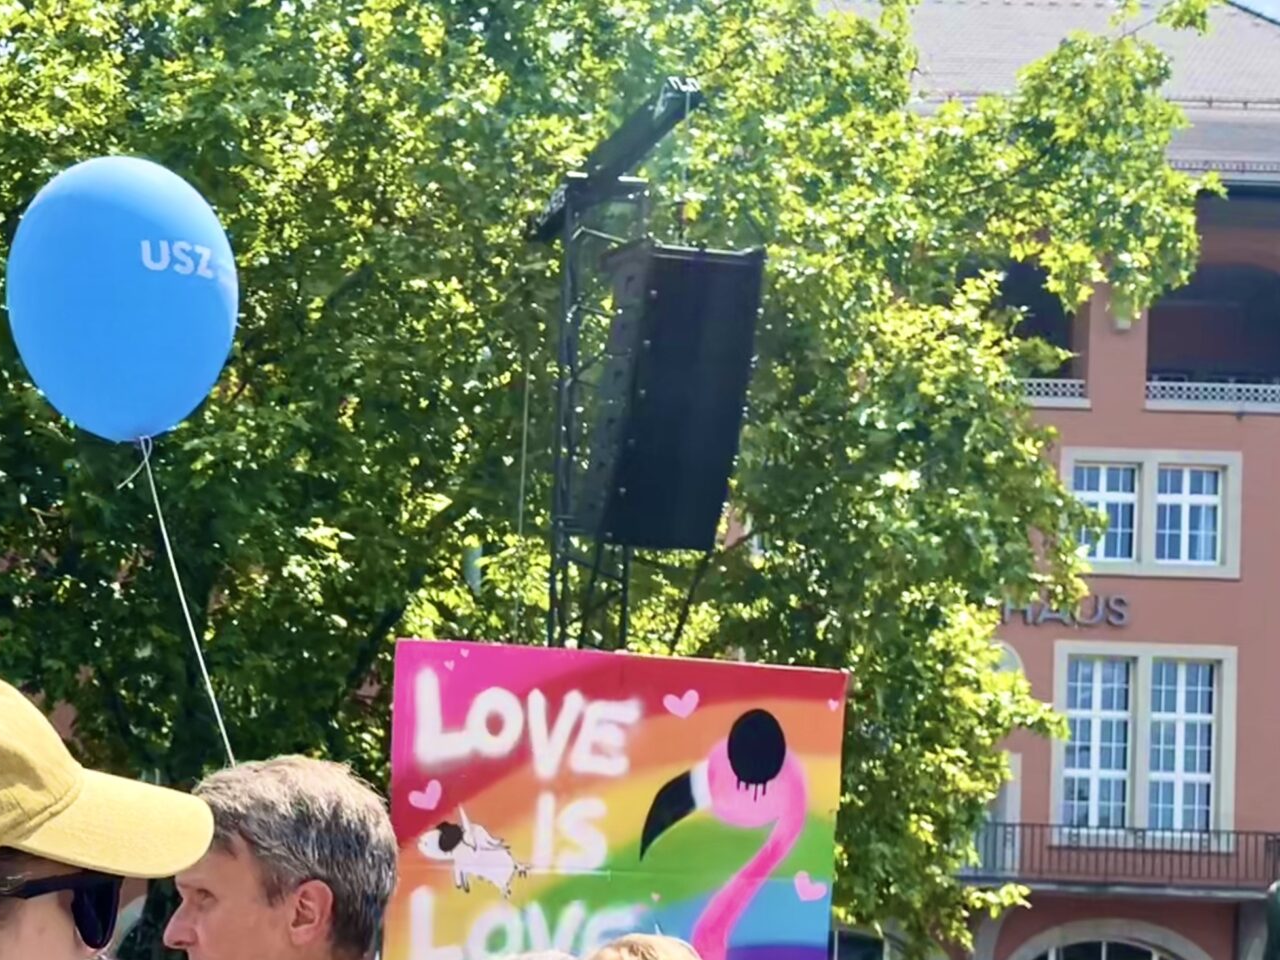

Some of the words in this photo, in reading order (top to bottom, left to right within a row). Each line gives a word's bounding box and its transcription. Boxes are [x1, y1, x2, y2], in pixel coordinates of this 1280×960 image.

[140, 239, 214, 279] USZ
[1002, 594, 1130, 628] HAUS
[413, 666, 643, 780] LOVE
[531, 791, 609, 873] IS
